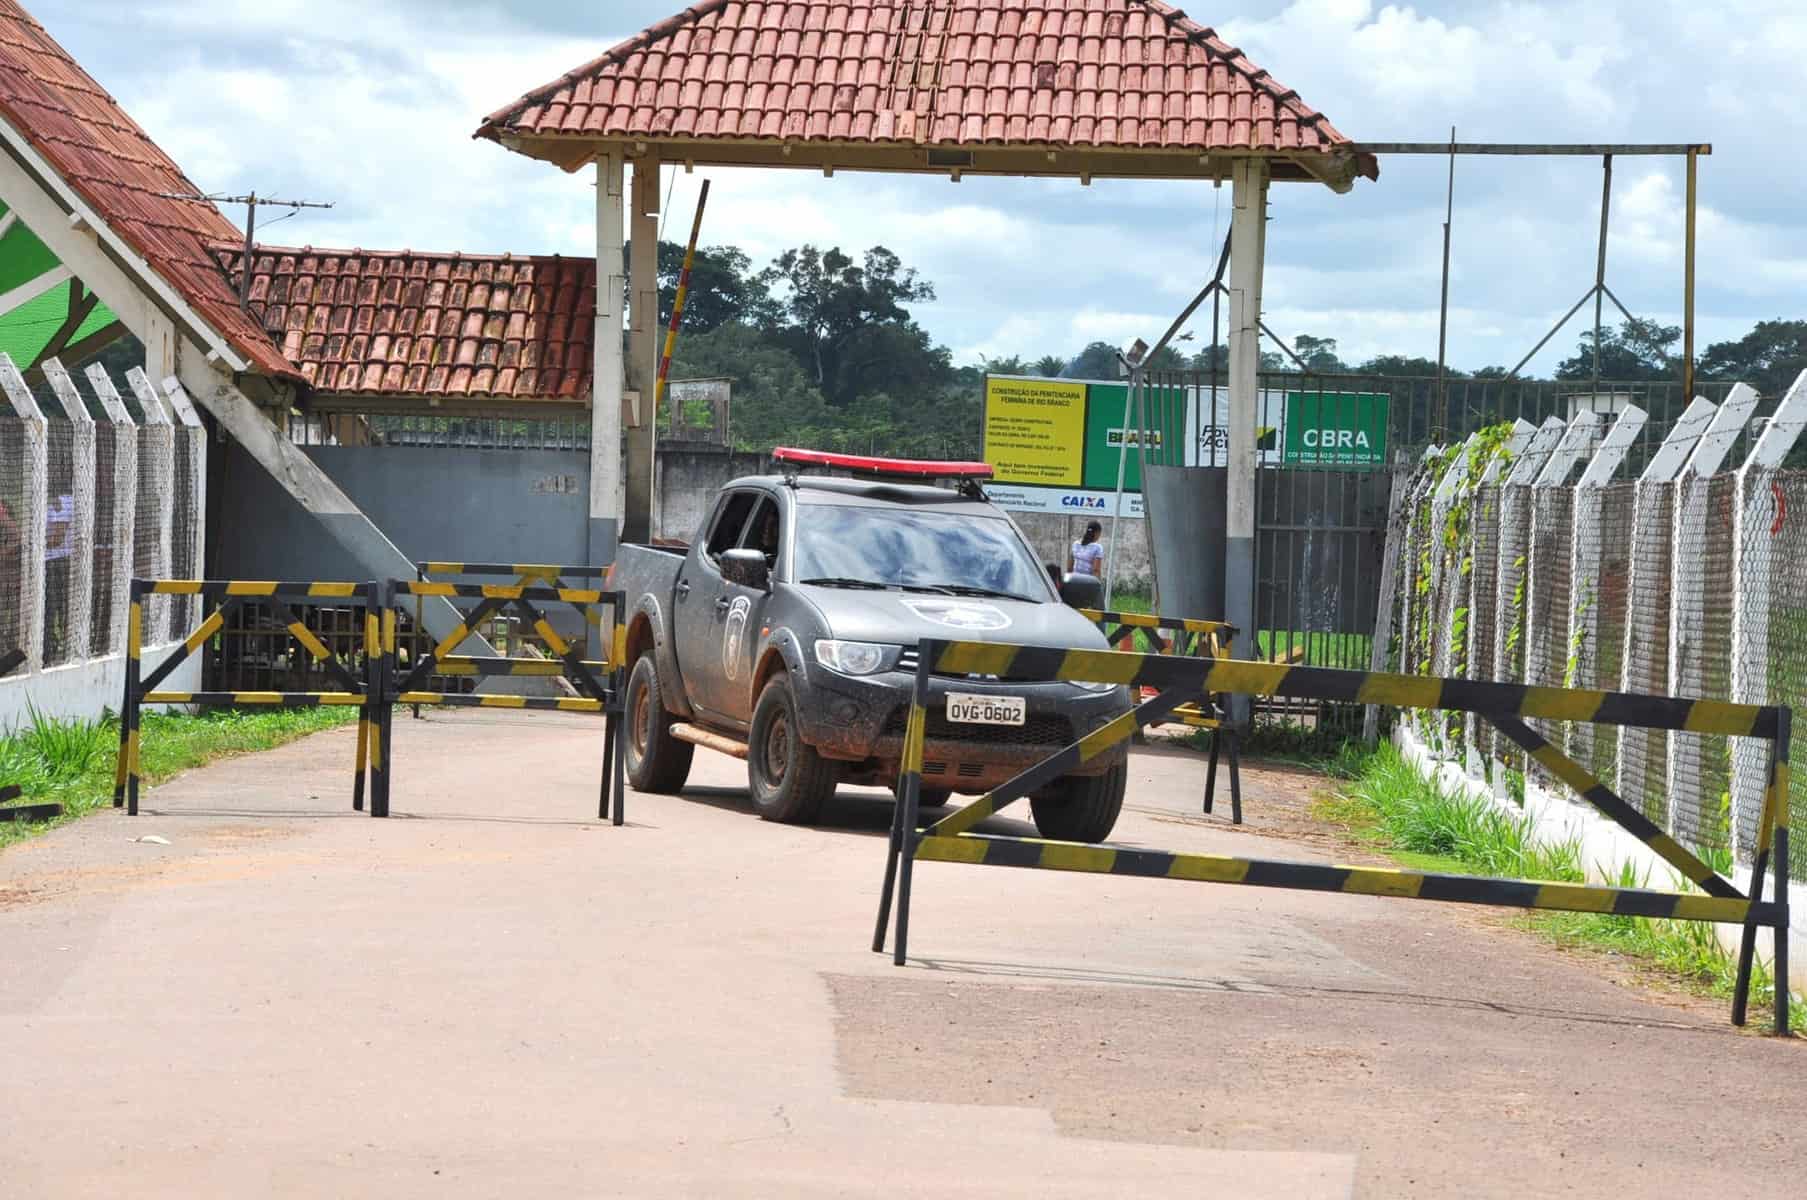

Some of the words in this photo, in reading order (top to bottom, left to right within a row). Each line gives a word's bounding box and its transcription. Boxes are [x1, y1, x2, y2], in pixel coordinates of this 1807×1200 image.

[1303, 429, 1369, 448] OBRA
[1062, 496, 1105, 508] CAIXA
[952, 704, 1021, 722] OVG-0602
